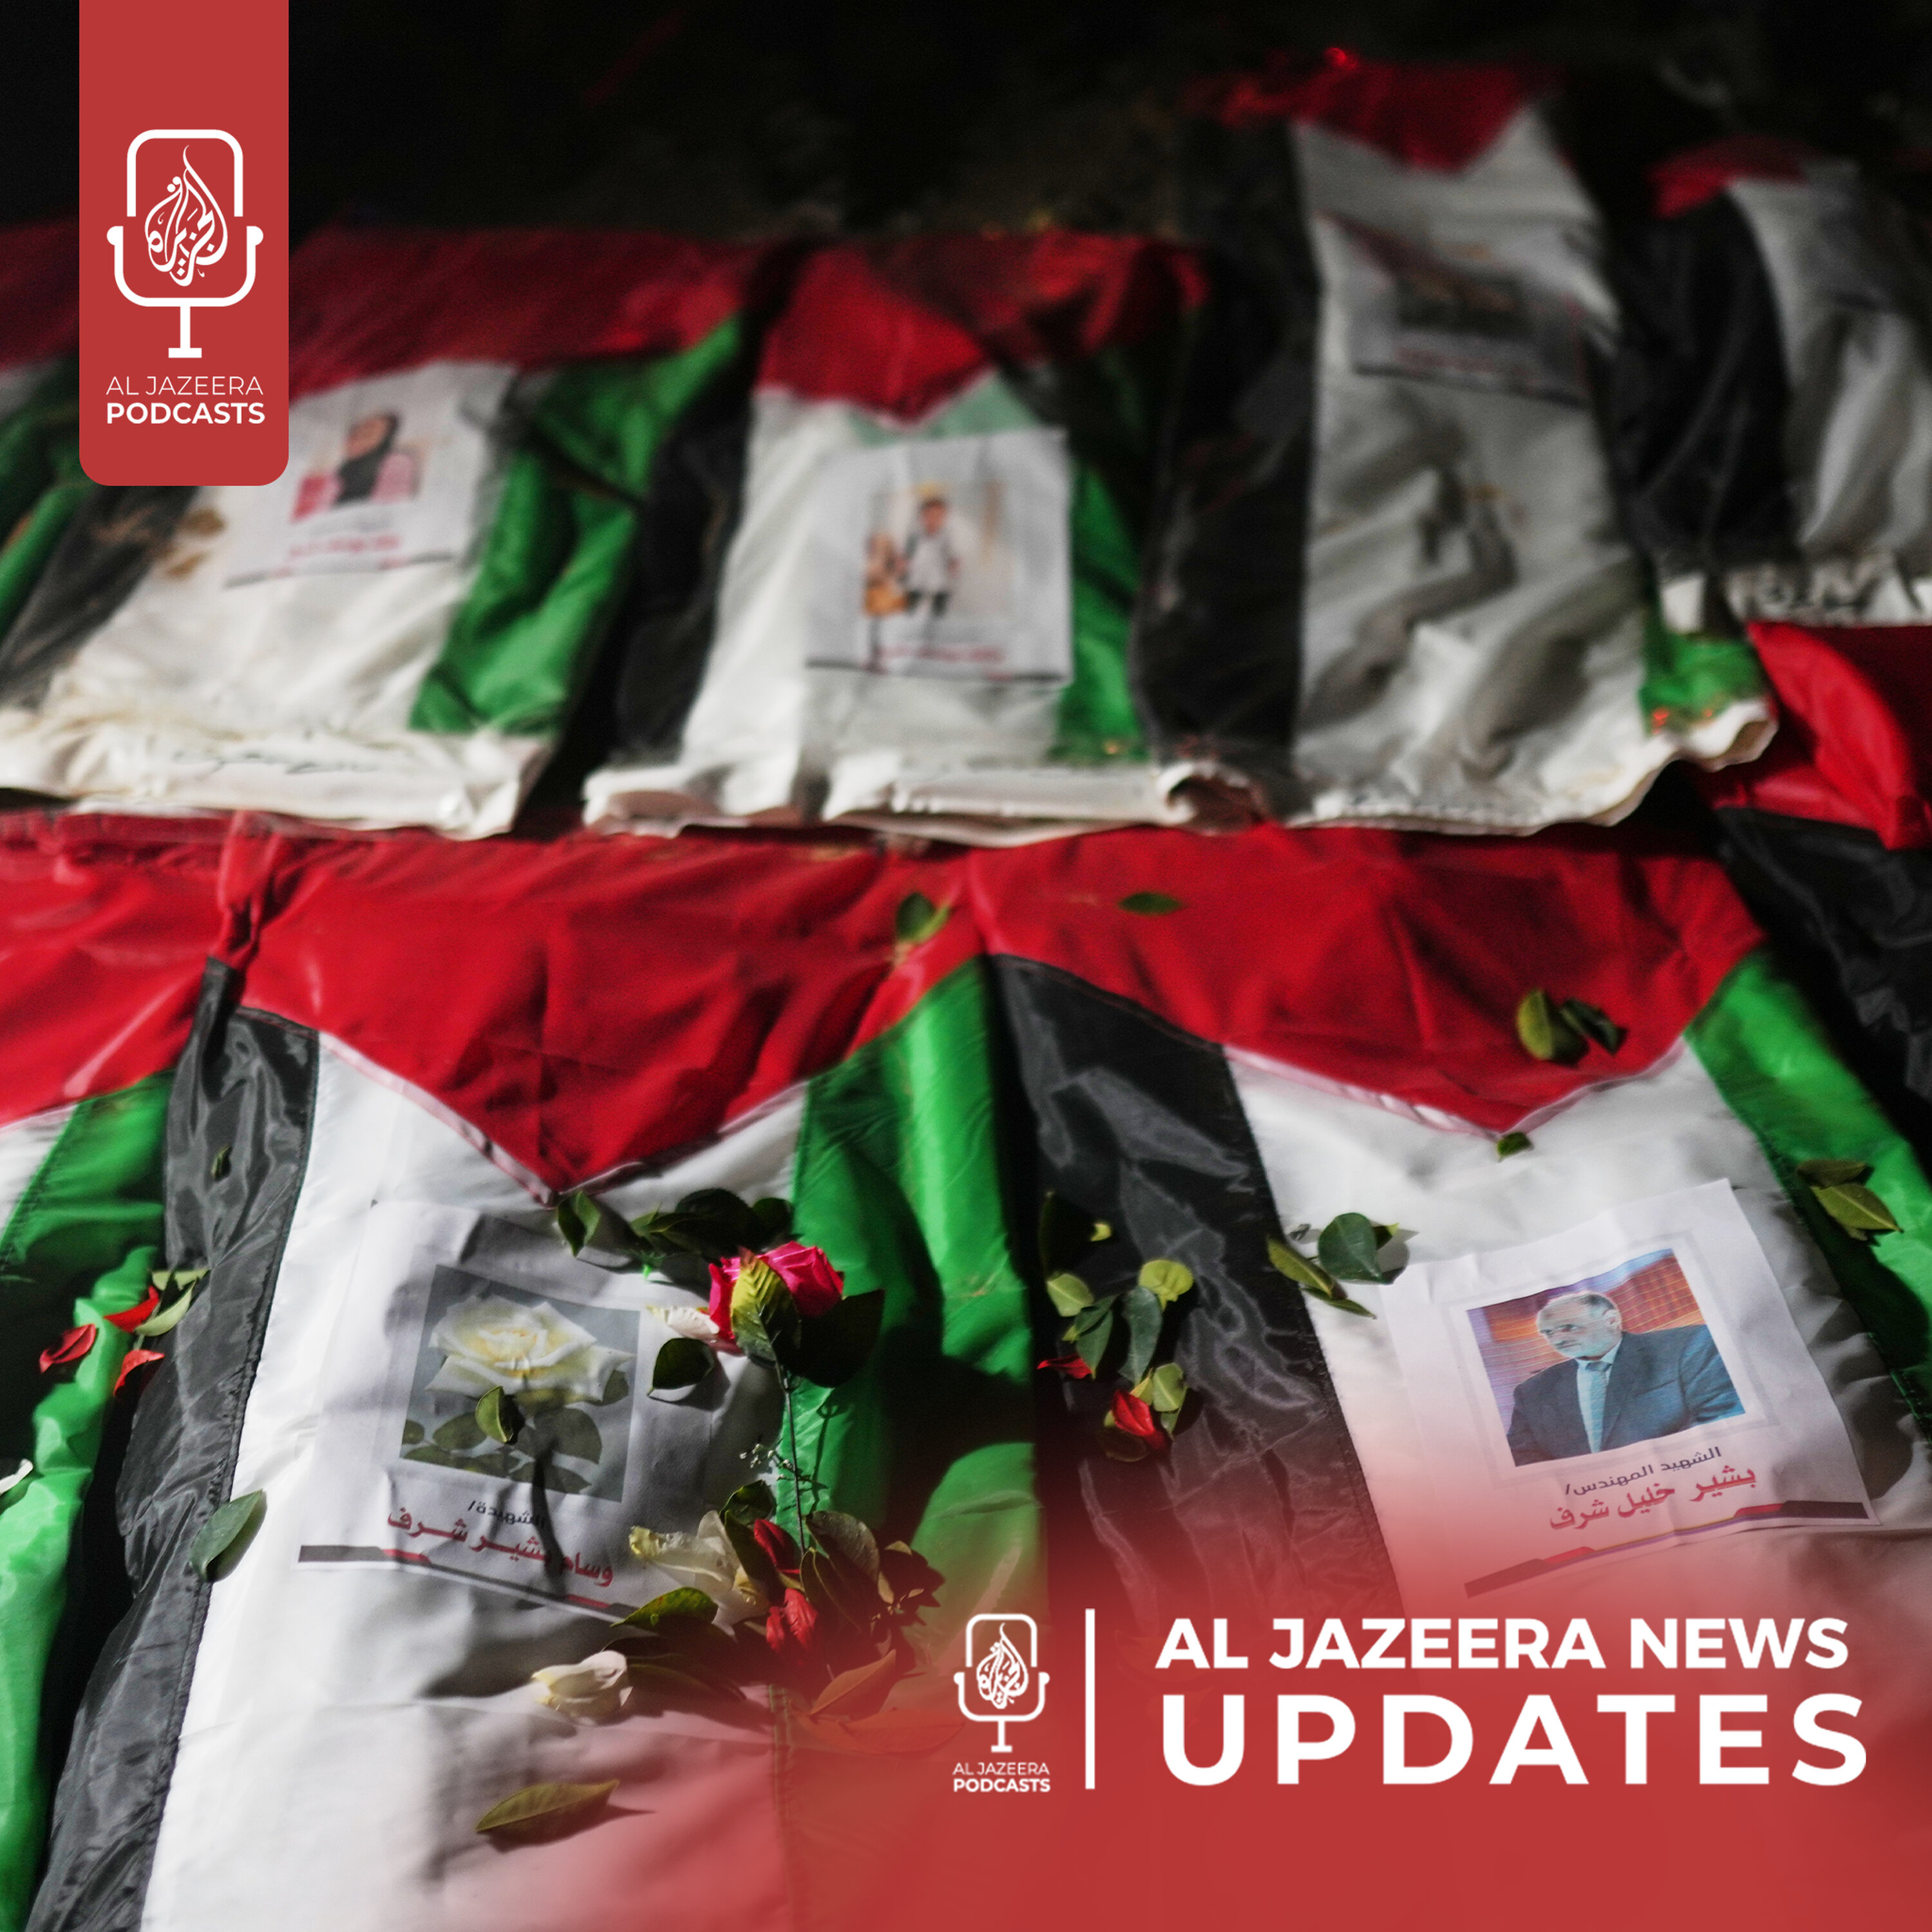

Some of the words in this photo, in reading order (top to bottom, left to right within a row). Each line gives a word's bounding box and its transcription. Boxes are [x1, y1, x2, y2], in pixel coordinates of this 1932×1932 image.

[1660, 1446, 1722, 1472] الشهيد
[1617, 1482, 1676, 1519] خليل
[1689, 1464, 1757, 1502] بشير
[388, 1507, 469, 1543] شرف
[1549, 1499, 1610, 1530] شرف
